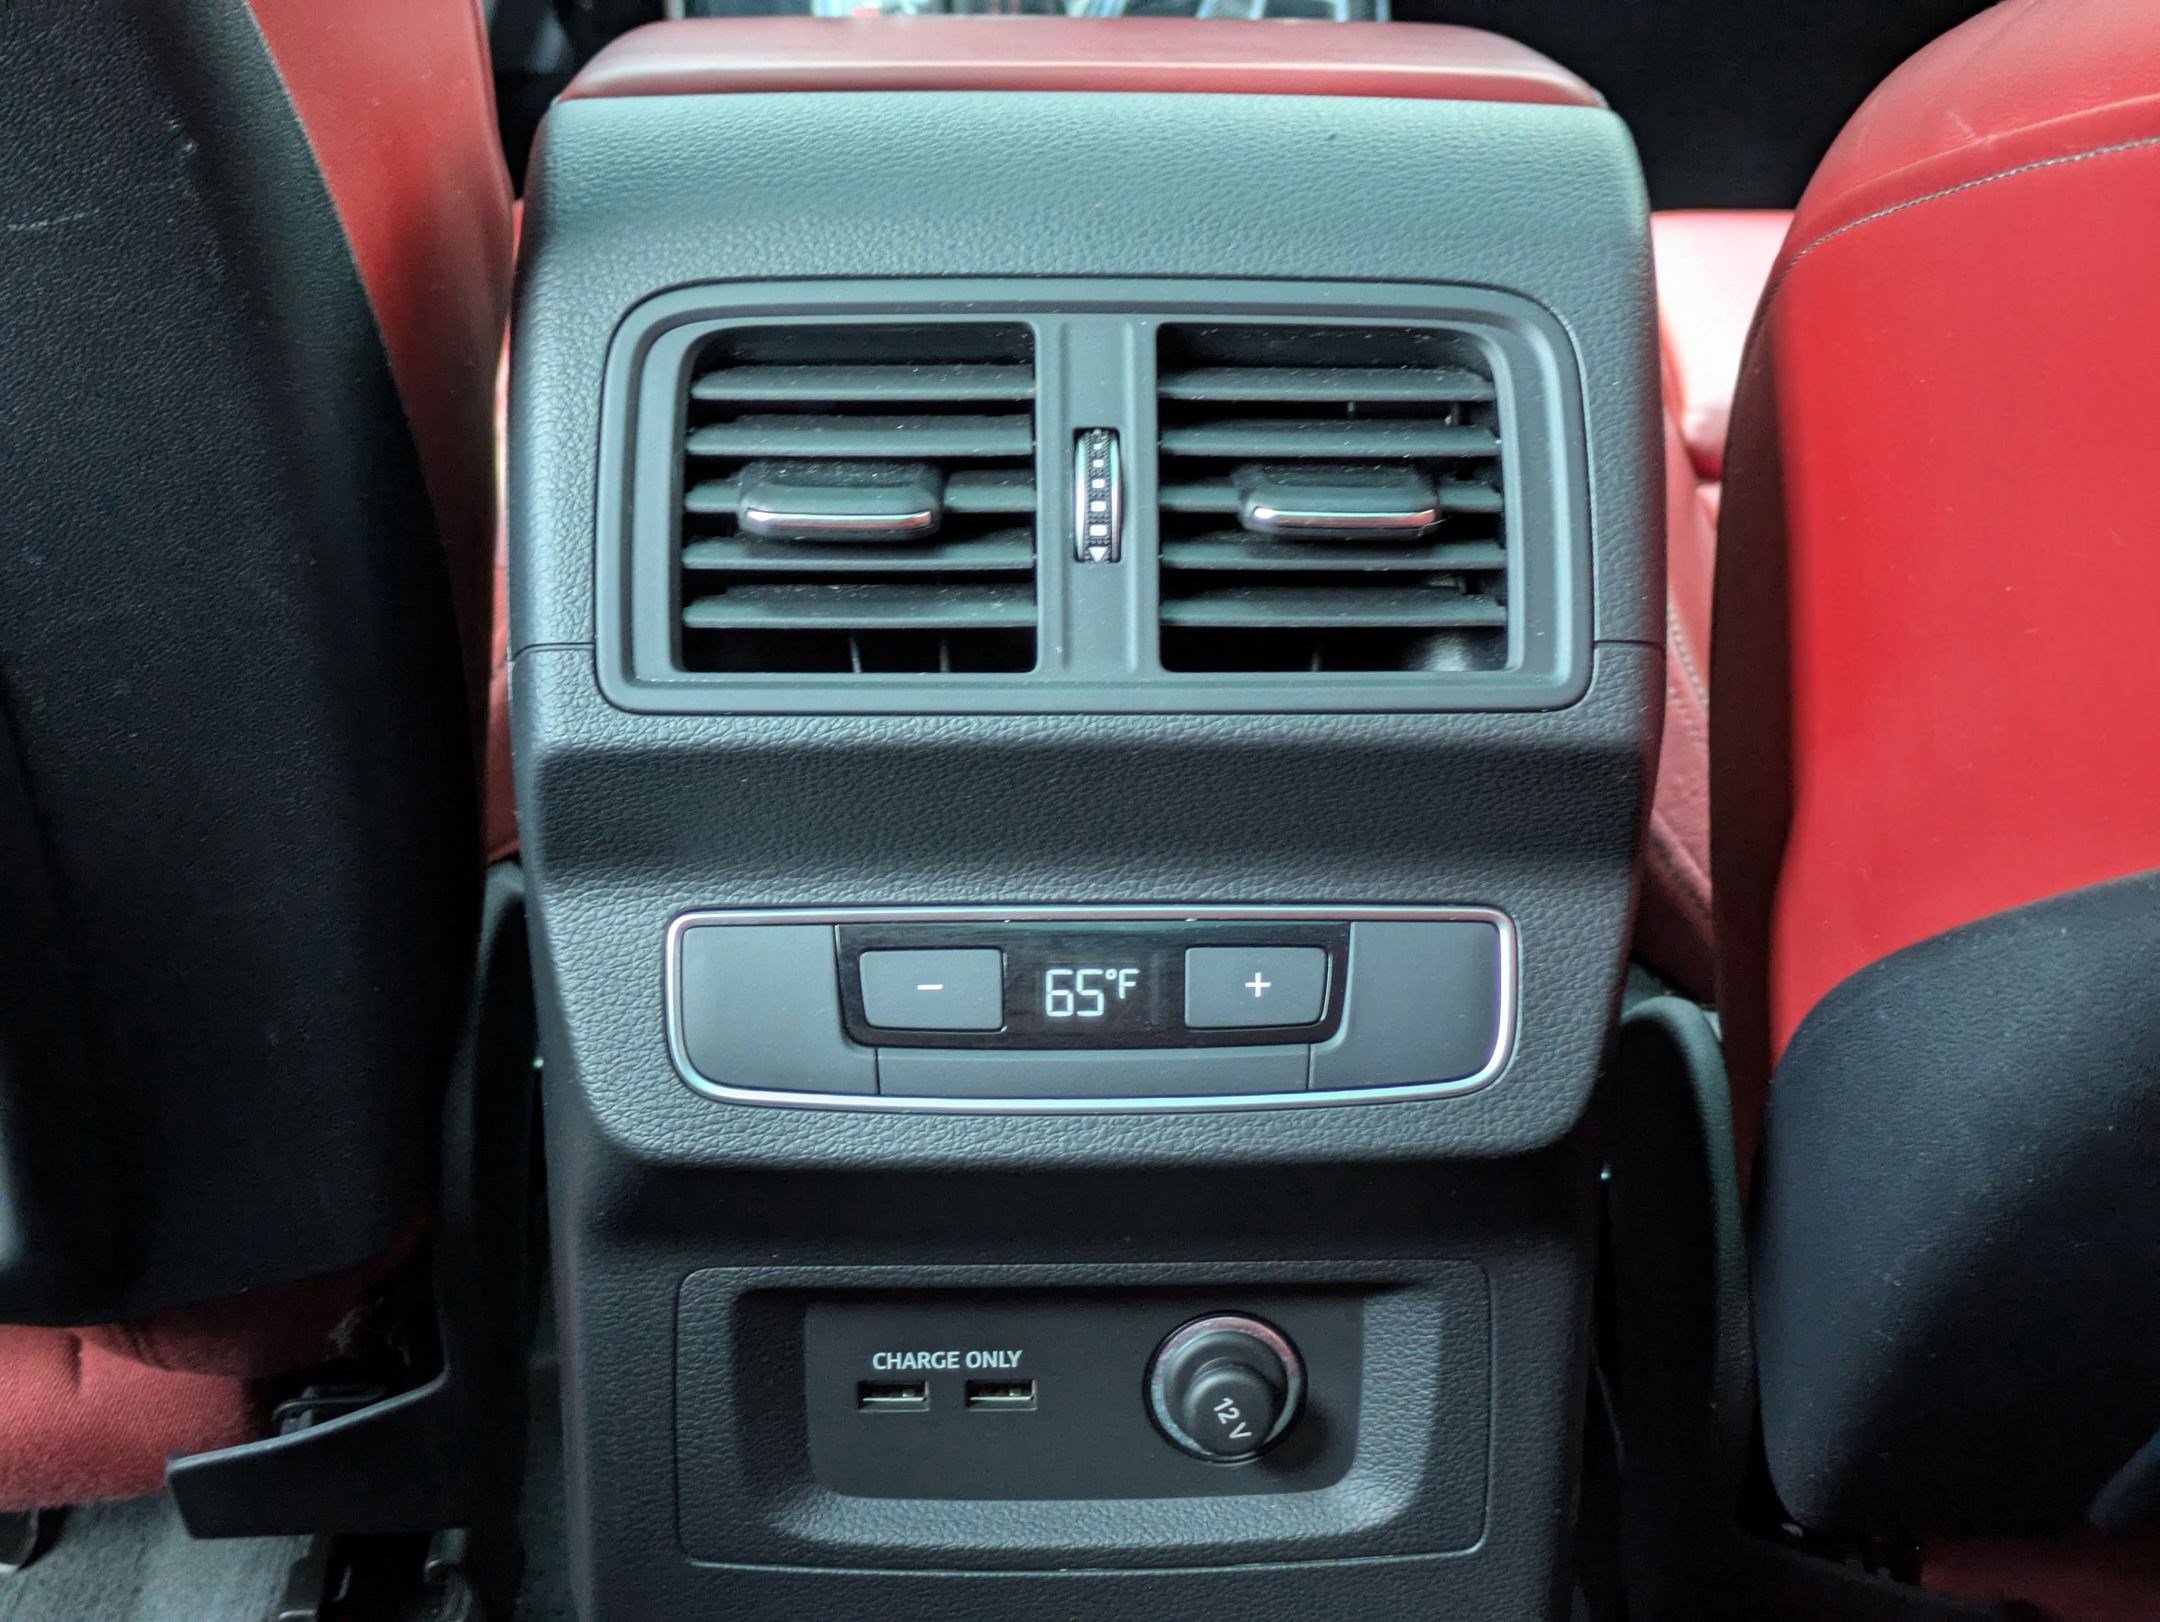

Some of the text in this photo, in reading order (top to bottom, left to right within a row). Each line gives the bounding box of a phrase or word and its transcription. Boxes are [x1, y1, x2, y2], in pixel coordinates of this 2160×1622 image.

[1045, 968, 1140, 1017] 65°F
[872, 1349, 1023, 1370] CHARGE ONLY
